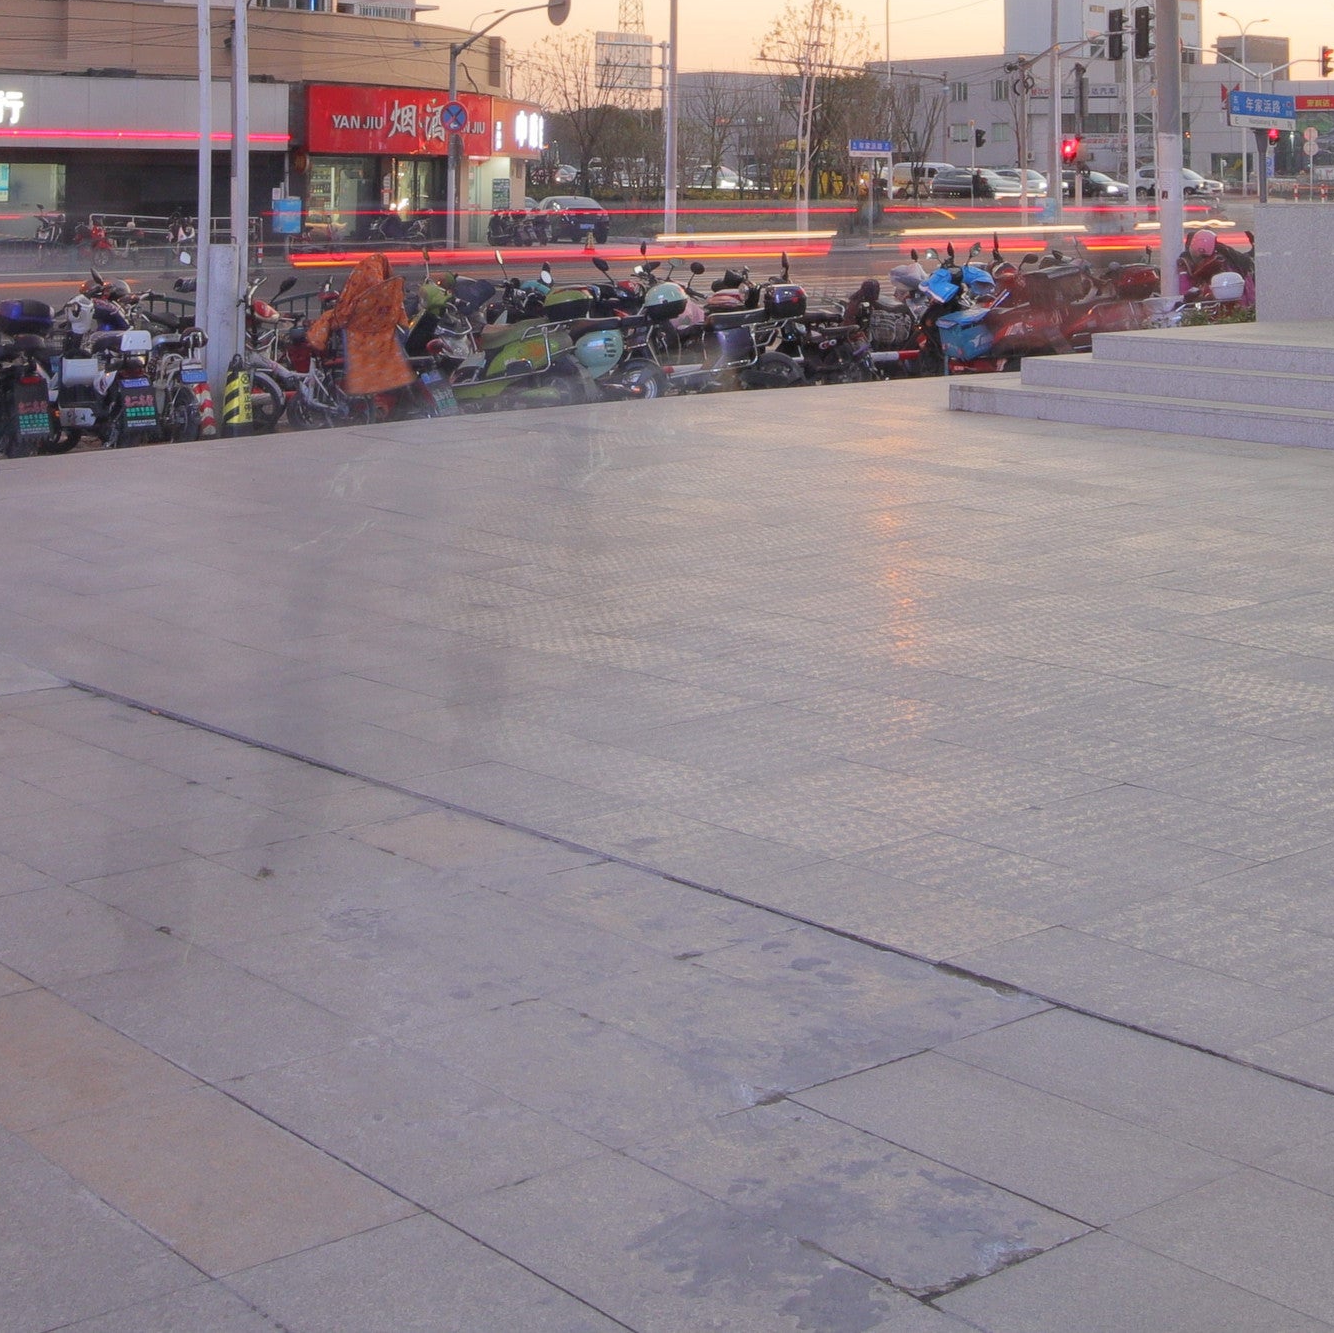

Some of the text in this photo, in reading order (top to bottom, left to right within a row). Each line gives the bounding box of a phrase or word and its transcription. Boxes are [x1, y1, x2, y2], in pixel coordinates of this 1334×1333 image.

[331, 114, 384, 131] YAN JIU
[471, 122, 485, 134] JIU
